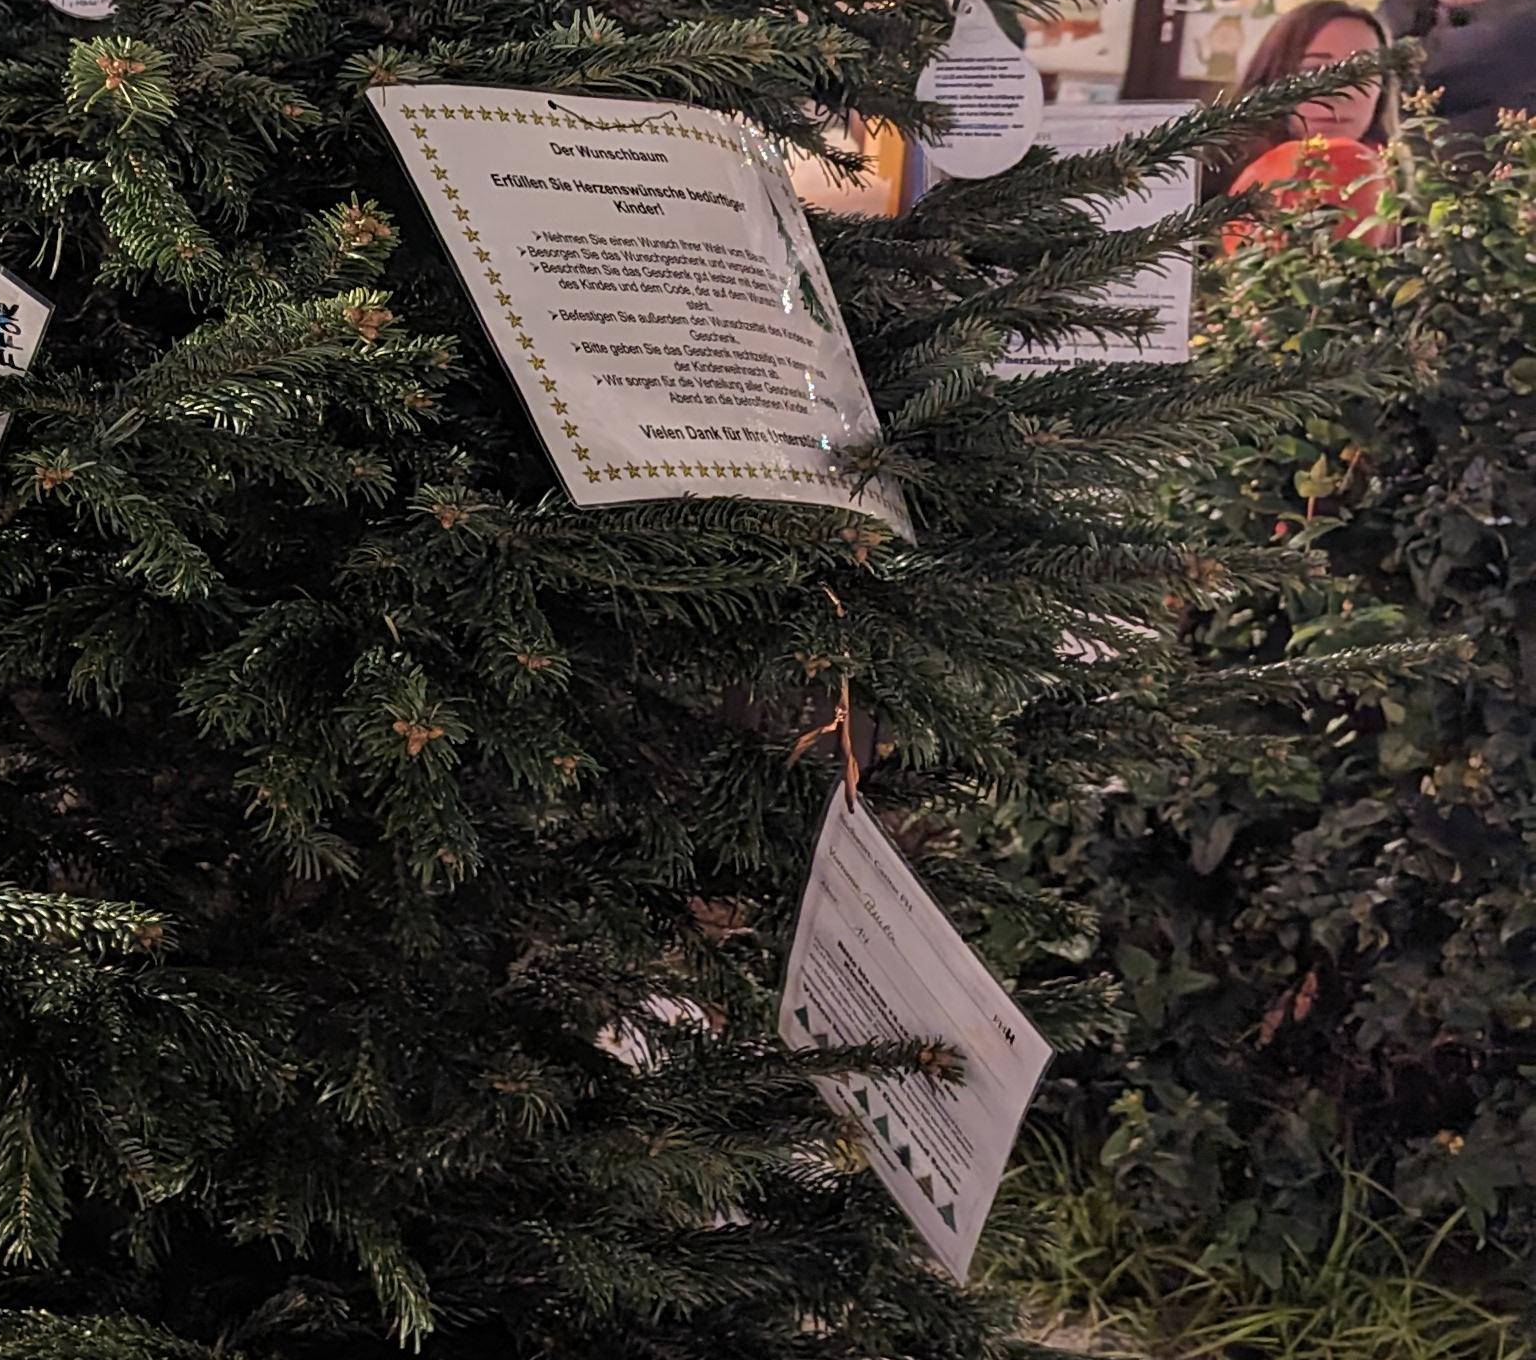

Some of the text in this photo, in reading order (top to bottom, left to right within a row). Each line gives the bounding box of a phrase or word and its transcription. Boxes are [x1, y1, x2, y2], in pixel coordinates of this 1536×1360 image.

[549, 142, 669, 163] Der Wunschbaum
[490, 173, 746, 212] Erfüllen Sie Herzenswünsche bedürftiger
[613, 200, 665, 216] Kinder!
[542, 231, 589, 244] Nehmen
[588, 233, 608, 246] Sie
[609, 235, 638, 247] einen
[636, 236, 680, 250] Wunsch
[527, 245, 581, 260] Besorgen
[580, 248, 600, 260] Sie
[600, 249, 622, 262] das
[620, 250, 707, 267] Wunschgeschenk
[708, 258, 726, 269] und
[540, 261, 602, 275] Beschriften
[601, 264, 621, 276] Sie
[622, 266, 642, 278] das
[641, 266, 693, 280] Geschenk
[558, 278, 580, 290] des
[578, 278, 618, 292] Kindes
[618, 281, 639, 292] und
[640, 282, 664, 293] dem
[694, 285, 711, 297] der
[558, 309, 618, 323] Befestigen
[617, 310, 637, 323] Sie
[638, 312, 690, 325] außerdem
[690, 315, 710, 326] den
[581, 341, 609, 354] Bitte
[609, 342, 644, 356] geben
[642, 343, 662, 356] Sie
[663, 344, 683, 356] das
[682, 344, 733, 358] Geschenk
[674, 361, 691, 372] der
[602, 374, 624, 386] Wir
[625, 377, 662, 390] sorgen
[660, 375, 676, 387] für
[678, 376, 695, 388] die
[693, 376, 745, 393] Verteilung
[669, 392, 703, 404] Abend
[703, 395, 718, 404] an
[718, 394, 734, 406] die
[638, 424, 686, 440] Vielen
[684, 425, 723, 440] Dank
[722, 426, 742, 441] für
[741, 427, 769, 443] Ihre
